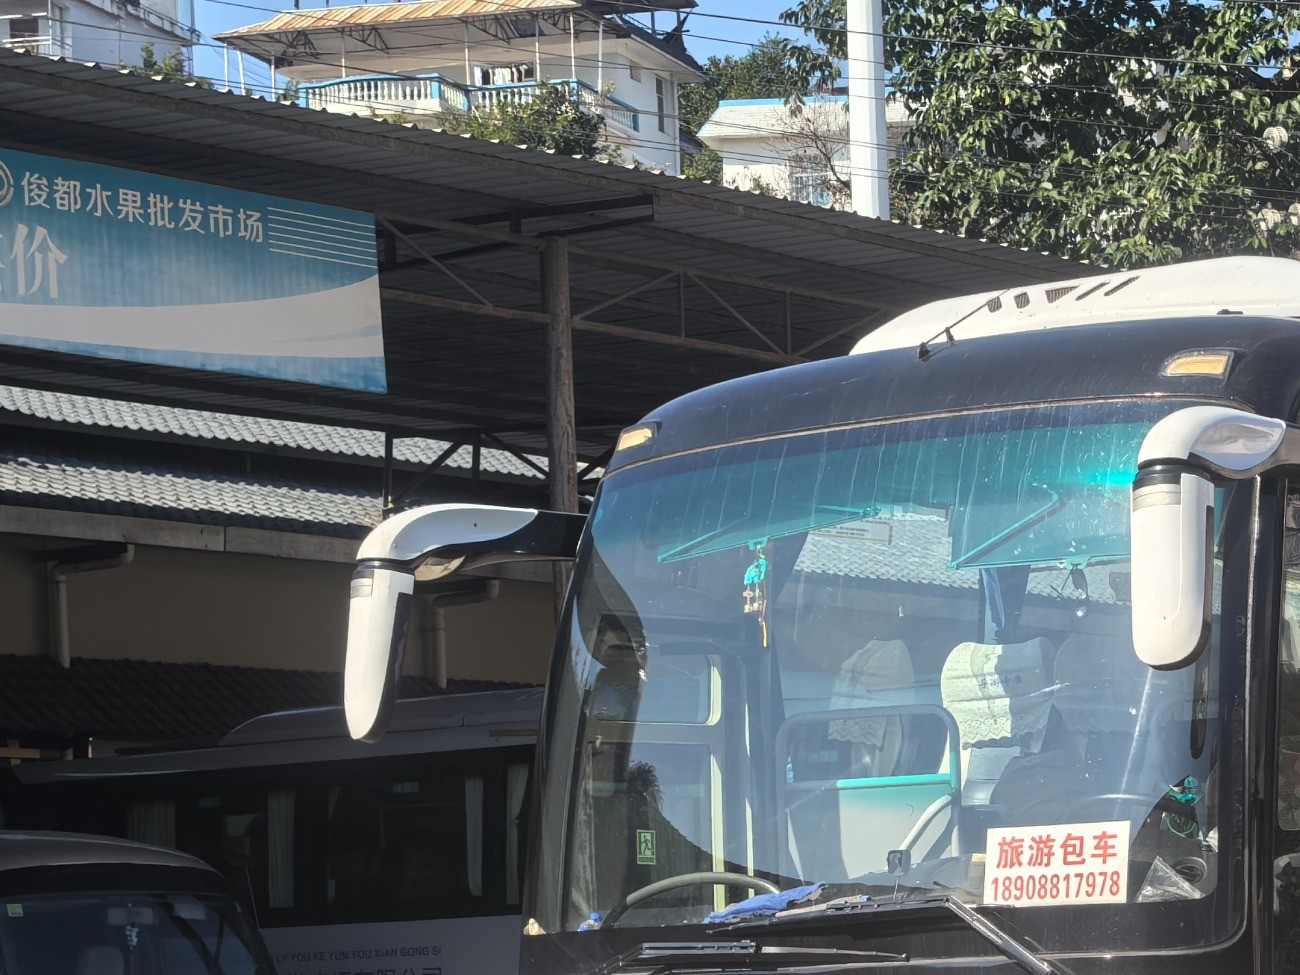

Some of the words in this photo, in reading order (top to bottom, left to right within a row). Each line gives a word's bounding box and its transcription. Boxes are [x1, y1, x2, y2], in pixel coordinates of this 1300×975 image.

[21, 171, 264, 243] 俊都水果批发市场
[0, 223, 68, 299] 价
[996, 831, 1118, 869] 旅游包车
[991, 870, 1121, 901] 18908817978
